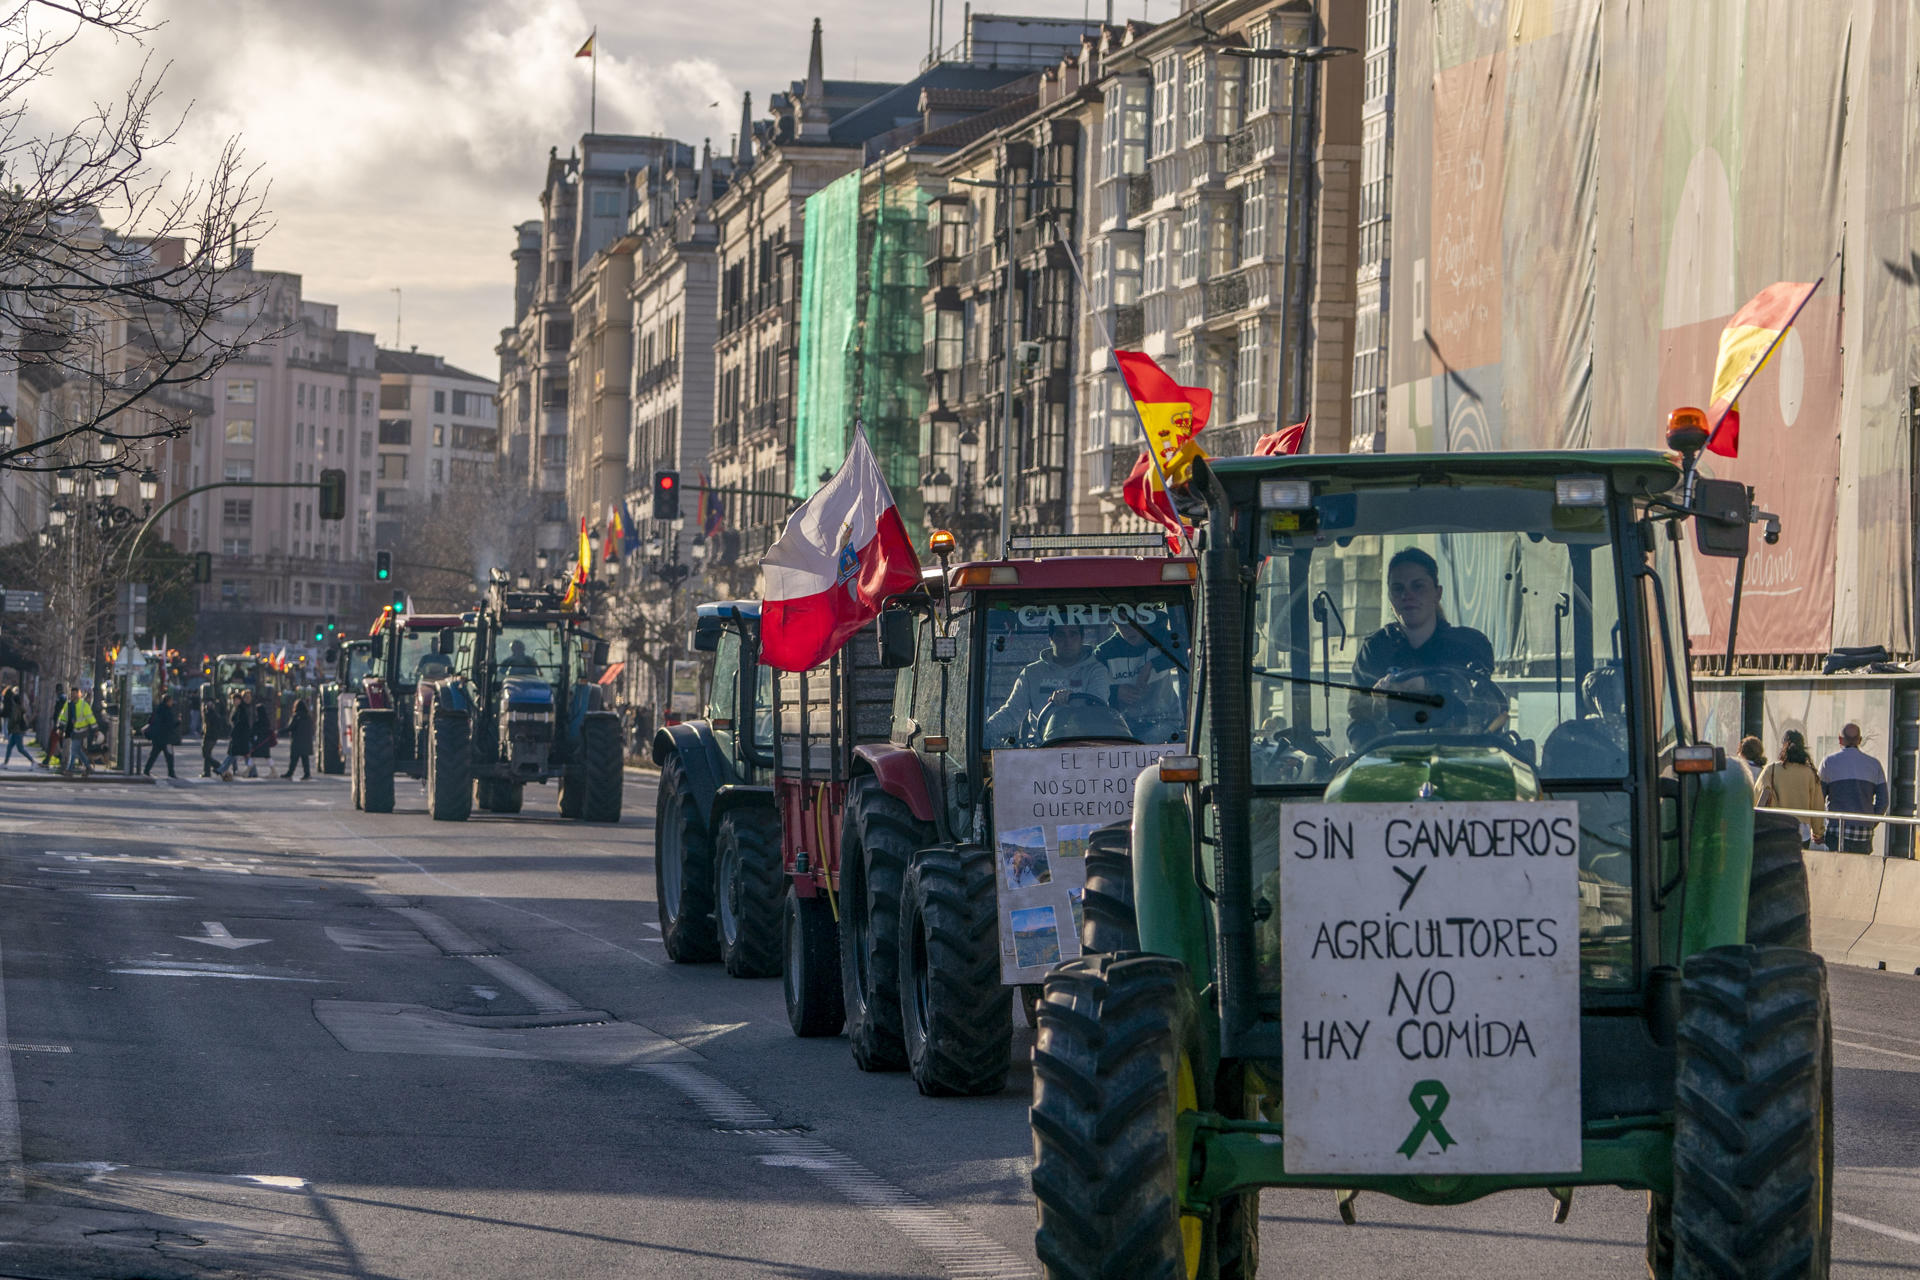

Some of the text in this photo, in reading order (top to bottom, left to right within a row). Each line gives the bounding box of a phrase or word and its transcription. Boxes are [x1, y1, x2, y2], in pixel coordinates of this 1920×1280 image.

[1018, 602, 1157, 627] CARLOS
[1060, 752, 1082, 770] EL
[1032, 800, 1134, 818] QUEREMOS
[1385, 817, 1577, 859] GANADEROS
[1392, 864, 1428, 911] Y
[1388, 968, 1456, 1017] NO
[1302, 1019, 1370, 1060] HAY
